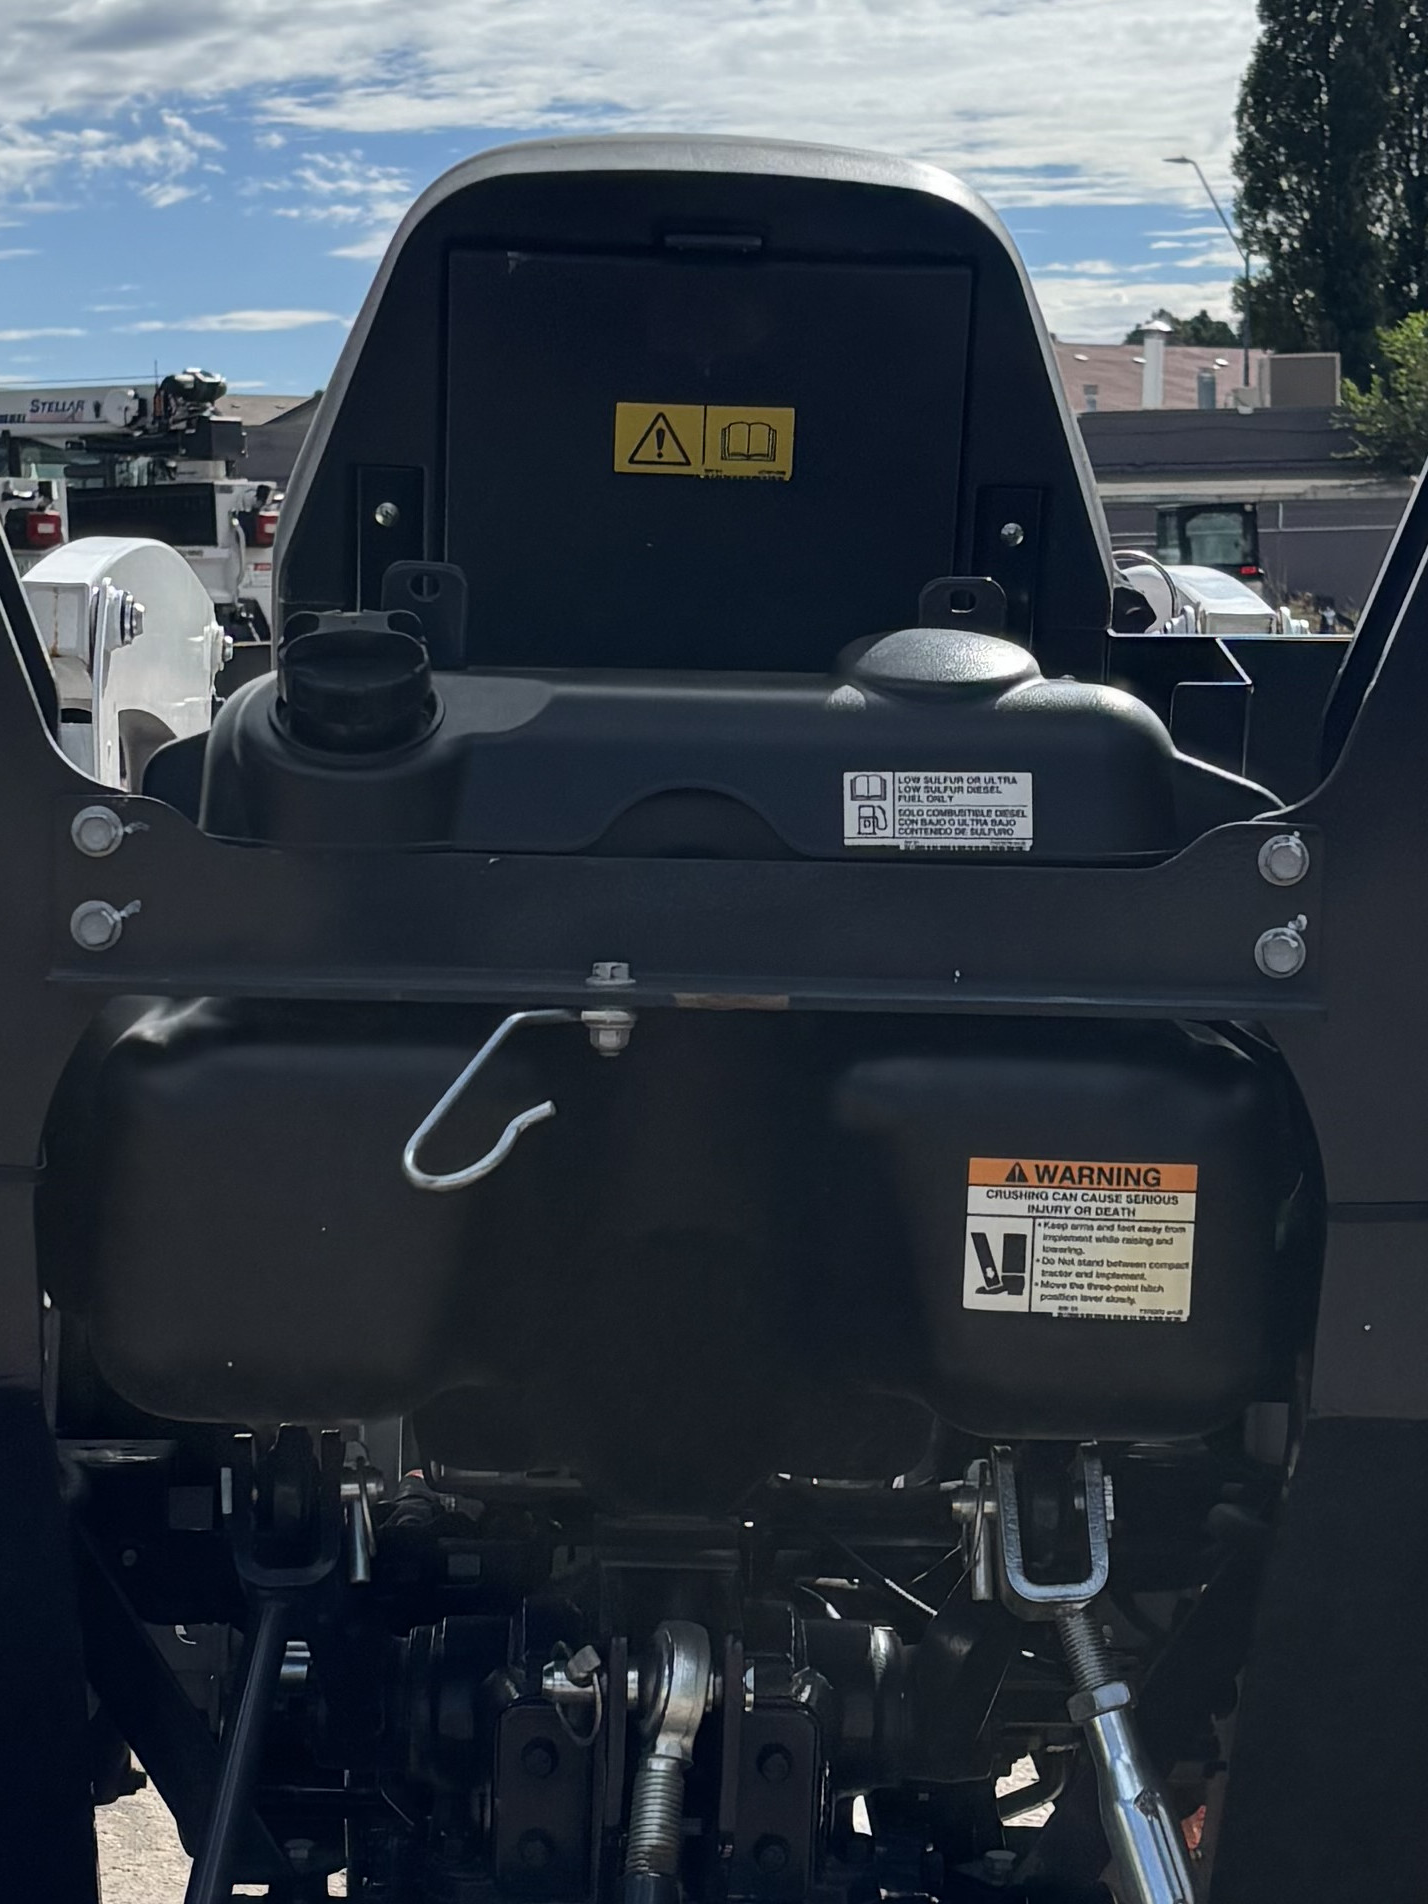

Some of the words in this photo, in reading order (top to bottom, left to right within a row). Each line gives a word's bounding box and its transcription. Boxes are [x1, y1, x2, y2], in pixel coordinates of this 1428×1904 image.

[897, 775, 921, 785] LOW
[923, 775, 964, 785] SULFUR
[966, 775, 981, 785] OR
[983, 775, 1018, 785] ULTRA
[897, 785, 921, 794] LOW
[923, 785, 964, 794] SULFUR
[966, 785, 1003, 794] DIESEL
[897, 794, 924, 803] FUEL
[926, 795, 954, 803] ONLY
[994, 809, 1028, 818] DIESEL
[897, 818, 919, 827] CON
[920, 818, 947, 827] BAJO
[957, 818, 989, 827] ULTRA
[990, 818, 1017, 827] BAJO
[969, 827, 1015, 836] SULFURO
[1034, 1164, 1162, 1187] WARNING
[985, 1188, 1049, 1201] CRUSHING
[1052, 1191, 1078, 1202] CAN
[1080, 1192, 1123, 1204] CAUSE
[1126, 1193, 1179, 1206] SERIOUS
[1026, 1204, 1072, 1215] INJURY
[1074, 1205, 1092, 1216] OR
[1095, 1206, 1136, 1218] DEATH
